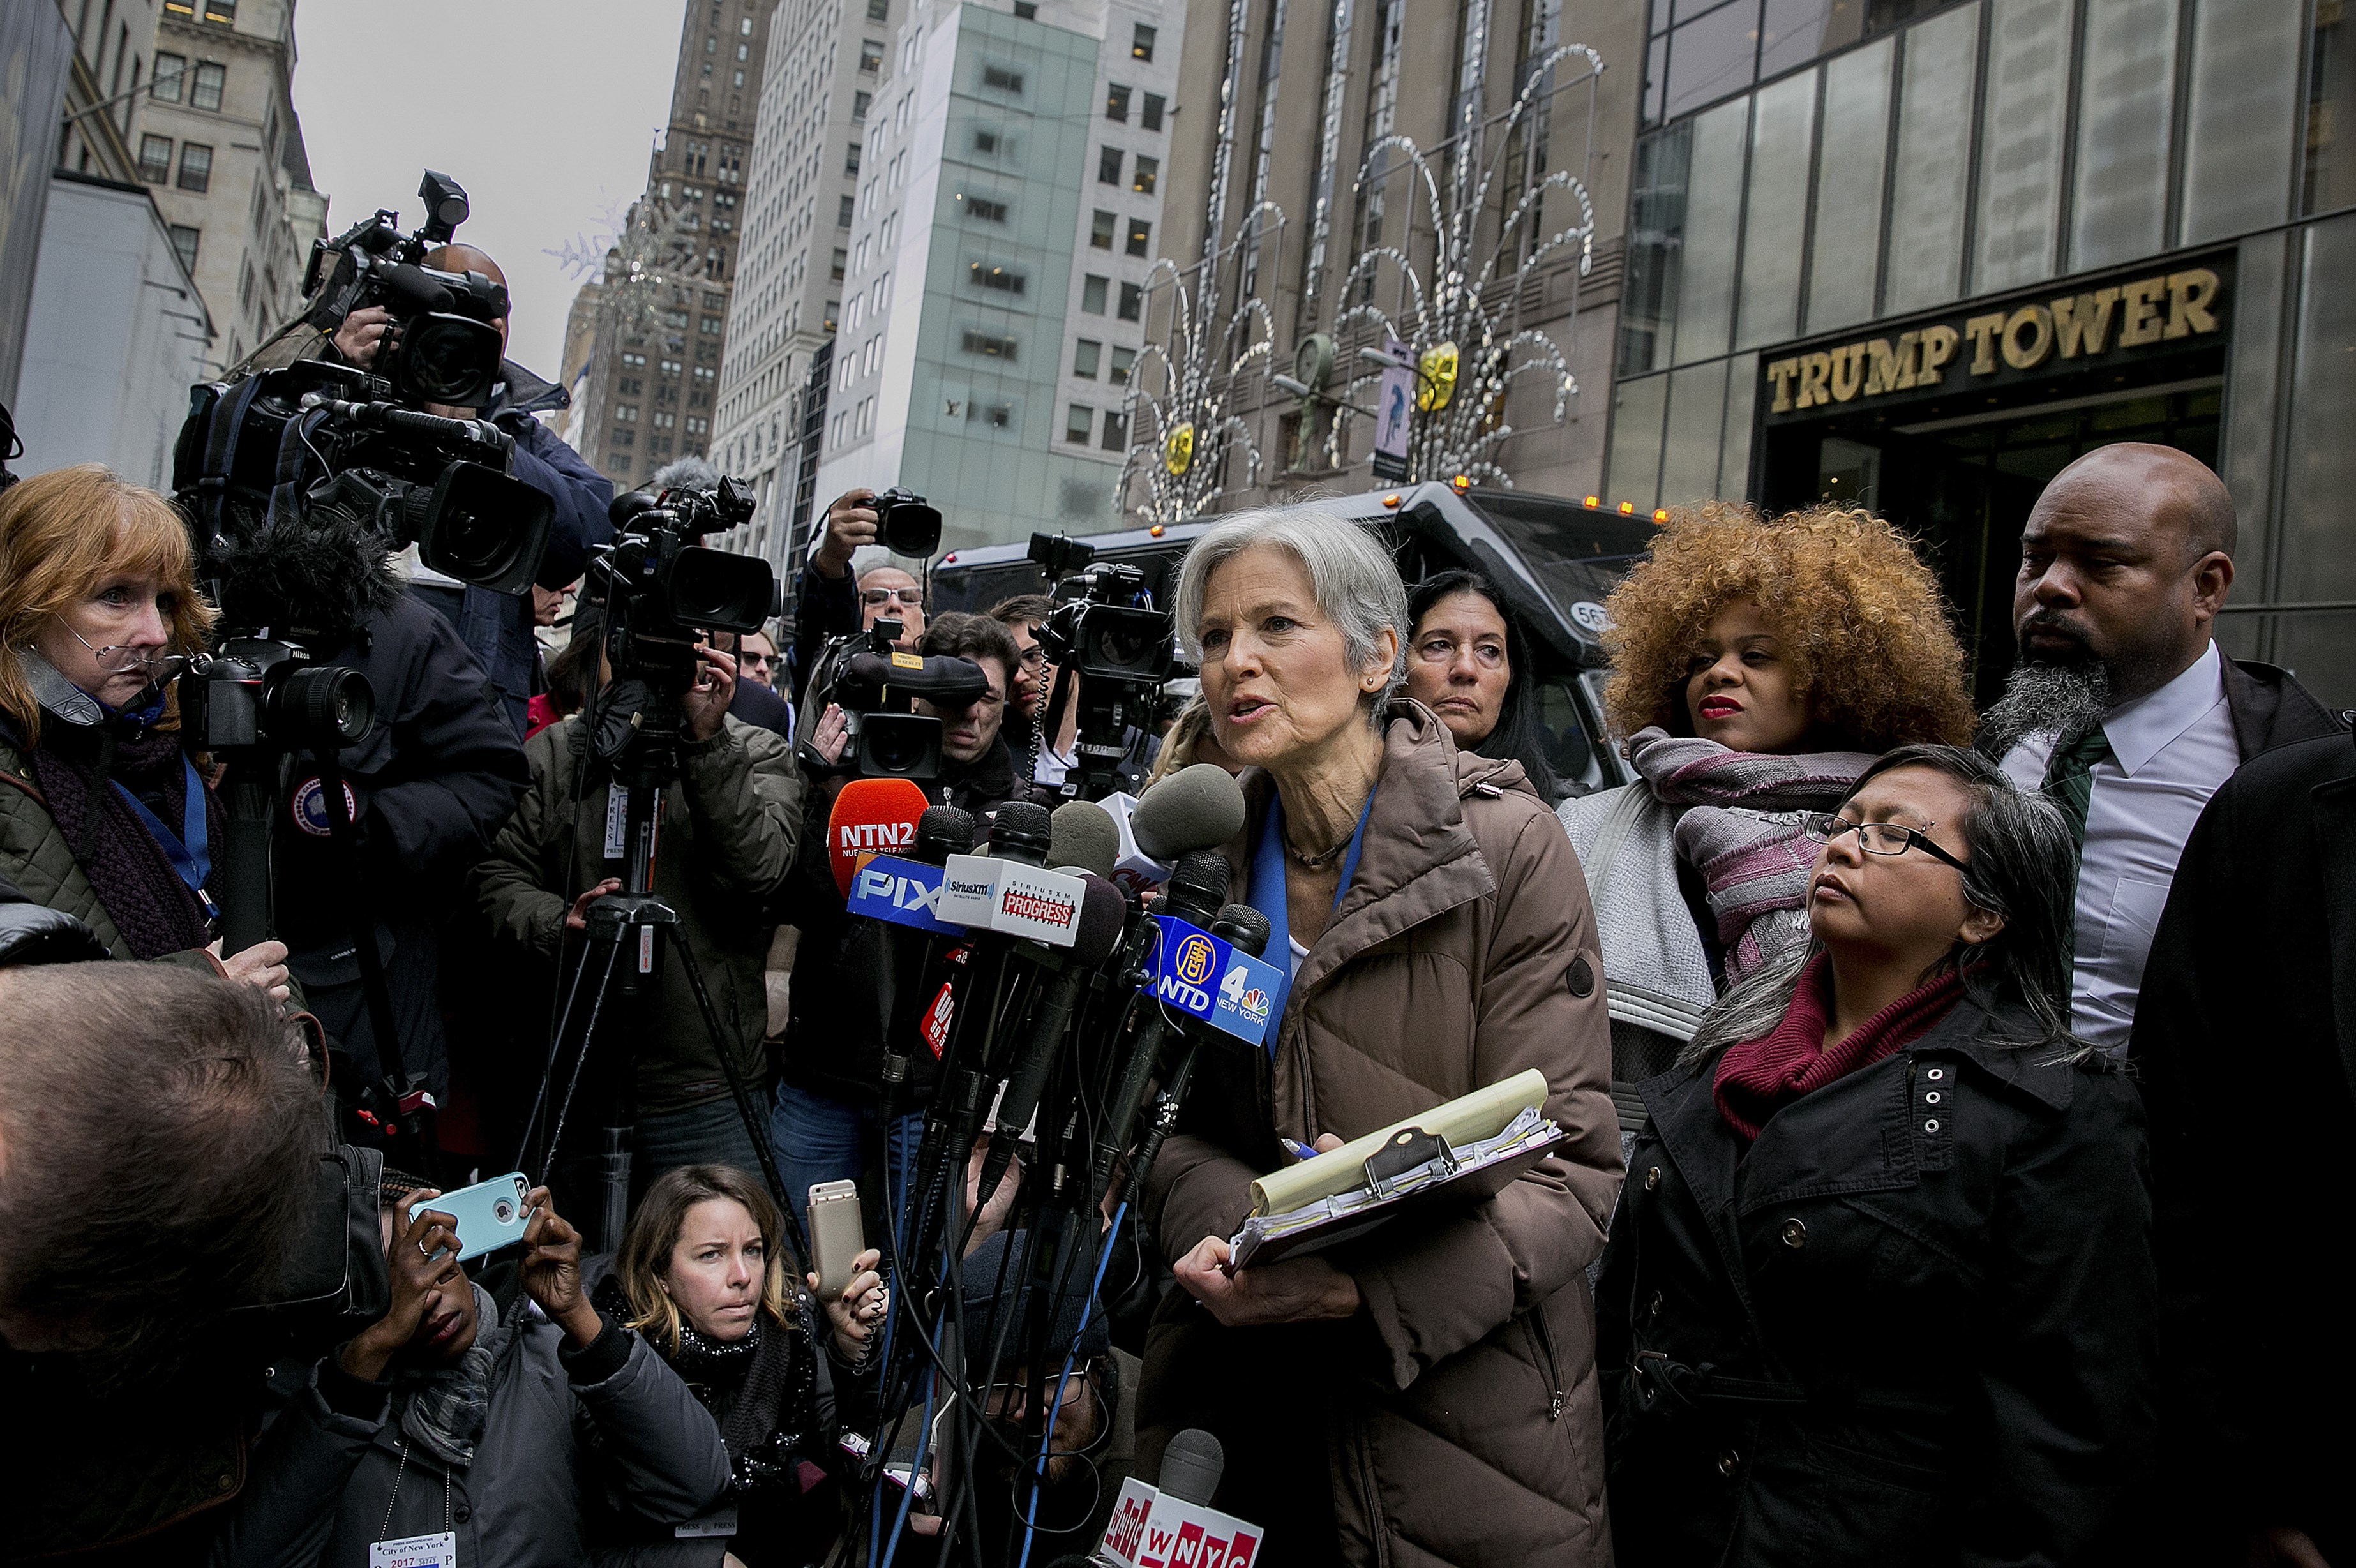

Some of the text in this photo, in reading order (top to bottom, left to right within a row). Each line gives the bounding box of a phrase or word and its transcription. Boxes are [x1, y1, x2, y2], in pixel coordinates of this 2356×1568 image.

[1767, 268, 2220, 414] TRUMP TOWER
[292, 650, 310, 659] Nikon
[607, 797, 616, 841] PRESS
[857, 869, 942, 915] PIX
[1005, 895, 1070, 922] PROGRESS
[1160, 975, 1210, 1012] NTD
[1220, 966, 1249, 1003] 4
[1217, 997, 1265, 1026] NEW YORK
[930, 1020, 947, 1047] 99.5
[1111, 1507, 1143, 1546] WNYC
[426, 1541, 444, 1549] York
[391, 1557, 415, 1568] 2017
